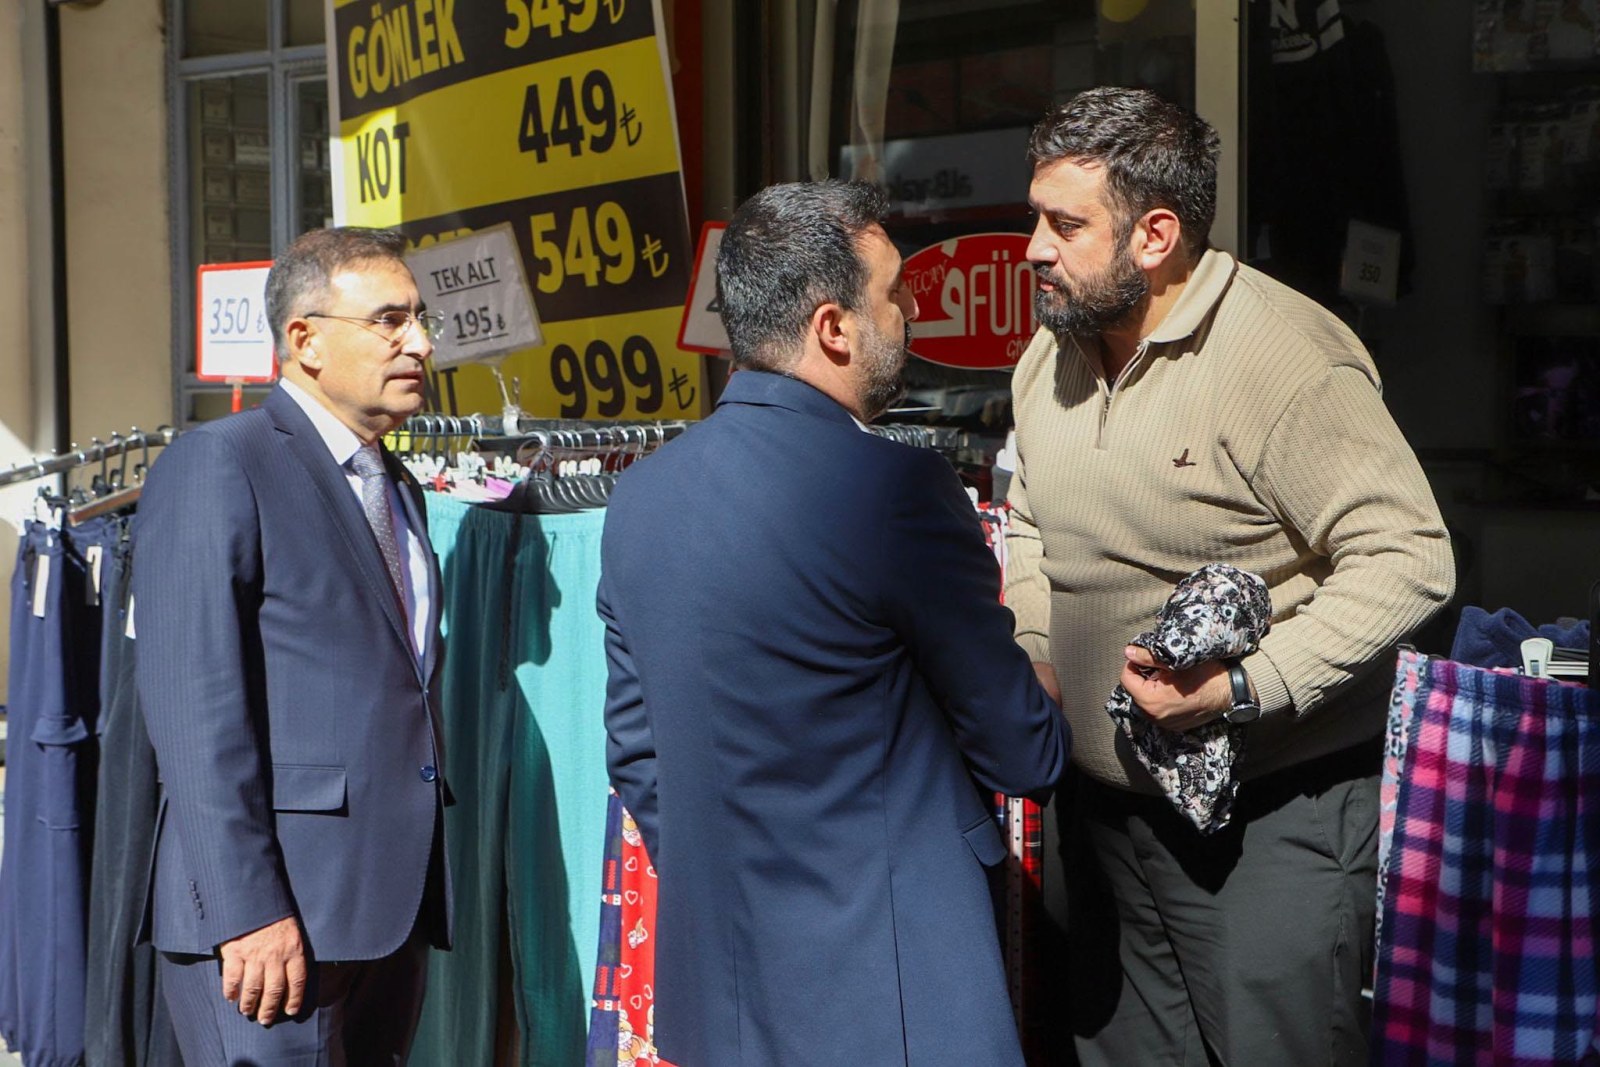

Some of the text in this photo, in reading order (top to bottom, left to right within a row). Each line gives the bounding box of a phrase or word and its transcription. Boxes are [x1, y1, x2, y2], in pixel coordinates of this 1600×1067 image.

[348, 0, 465, 99] GÖMLEK
[356, 122, 410, 204] KOT
[430, 257, 497, 291] TEK ALT
[210, 297, 251, 335] 350
[453, 306, 493, 339] 195
